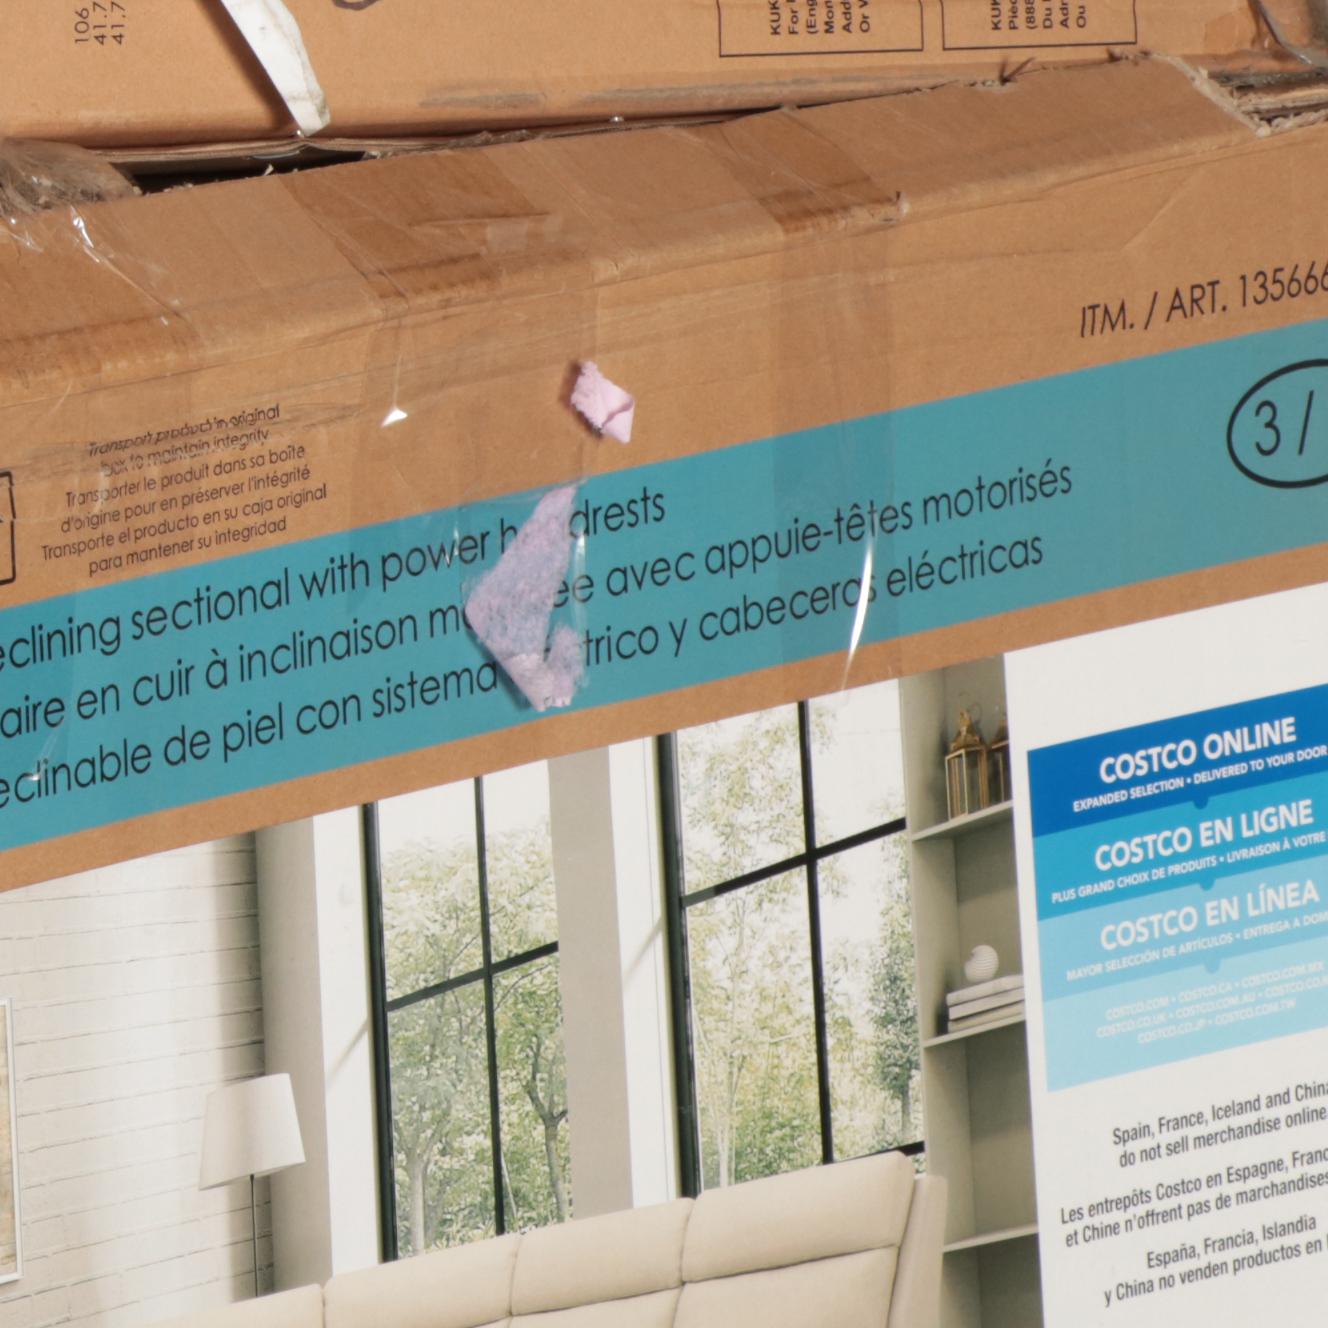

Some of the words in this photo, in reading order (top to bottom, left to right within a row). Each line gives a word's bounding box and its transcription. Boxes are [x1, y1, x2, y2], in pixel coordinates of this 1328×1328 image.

[75, 7, 90, 45] 106
[93, 2, 107, 46] 41.7
[788, 8, 799, 35] For
[1080, 304, 1135, 338] ITM.
[1166, 280, 1227, 323] ART.
[1254, 399, 1281, 456] 3
[88, 556, 122, 576] para
[126, 539, 194, 566] mantener
[198, 535, 212, 550] su
[215, 516, 286, 544] integridad
[606, 553, 695, 596] avec
[705, 499, 912, 579] appuie-têtes
[923, 459, 1072, 525] motorisés
[131, 566, 291, 640] sectional
[300, 552, 369, 601] with
[382, 528, 489, 591] power
[669, 616, 687, 657] y
[699, 576, 876, 642] cabeceras
[886, 534, 1044, 599] eléctricas
[76, 681, 120, 721] en
[132, 658, 192, 707] cuir
[205, 649, 228, 688] à
[239, 612, 418, 682] inclinaison
[163, 726, 210, 765] de
[223, 701, 283, 762] piel
[296, 690, 361, 736] con
[373, 658, 498, 718] sistema
[1073, 790, 1127, 812] EXPANDED
[1130, 777, 1184, 799] SELECTION
[1194, 763, 1247, 784] DELIVERED
[1250, 759, 1264, 771] TO
[1267, 752, 1294, 768] YOUR
[1297, 746, 1327, 762] DOOR
[1100, 740, 1196, 783] COSTCO
[1203, 717, 1296, 759] ONLINE
[1095, 827, 1192, 871] COSTCO
[1200, 818, 1233, 847] EN
[1241, 800, 1313, 837] LIGNE
[1101, 907, 1197, 950] COSTCO
[1206, 897, 1239, 926] EN
[1247, 880, 1320, 917] LÍNEA
[1113, 1122, 1155, 1147] Spain,
[1159, 1110, 1208, 1135] France,
[1212, 1095, 1261, 1121] Iceland
[1265, 1087, 1290, 1109] and
[1119, 1151, 1136, 1168] do
[1140, 1144, 1161, 1163] not
[1166, 1135, 1189, 1157] sell
[1193, 1117, 1280, 1150] merchandise
[1285, 1107, 1327, 1128] online
